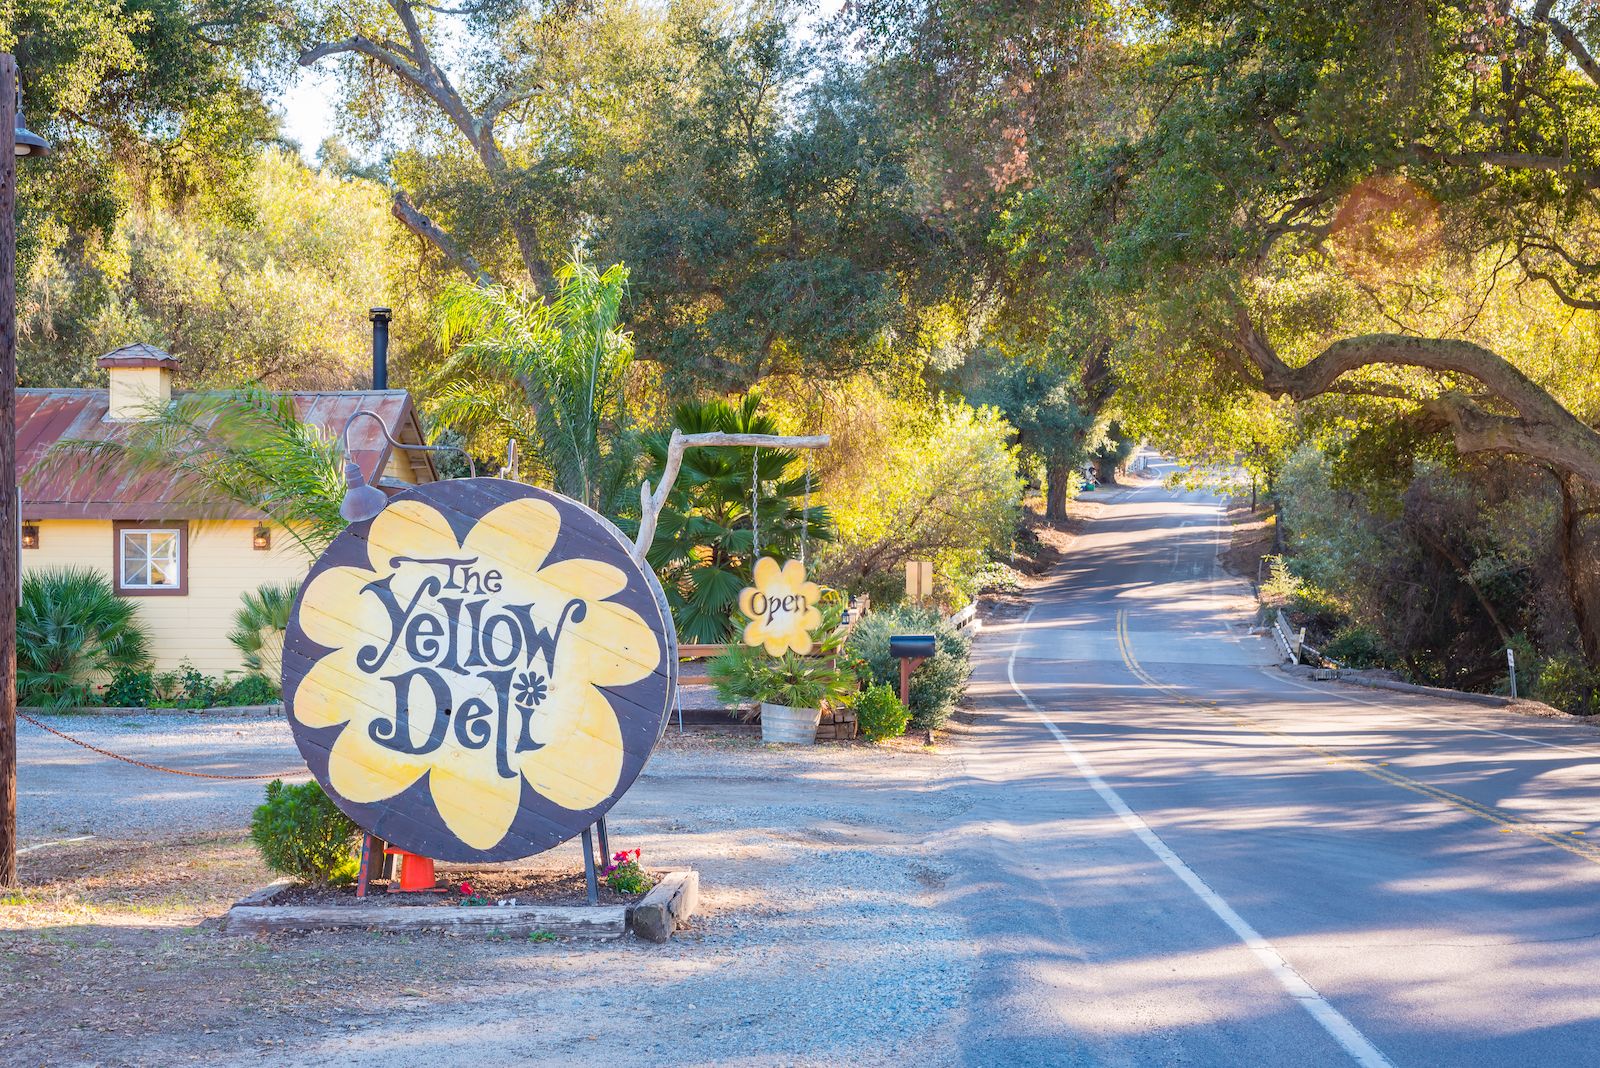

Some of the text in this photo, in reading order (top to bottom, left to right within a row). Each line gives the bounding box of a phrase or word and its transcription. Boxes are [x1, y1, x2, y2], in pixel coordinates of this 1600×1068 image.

[389, 556, 503, 595] The
[751, 591, 808, 627] Open
[356, 573, 588, 680] Yellow
[368, 667, 547, 779] Deli
